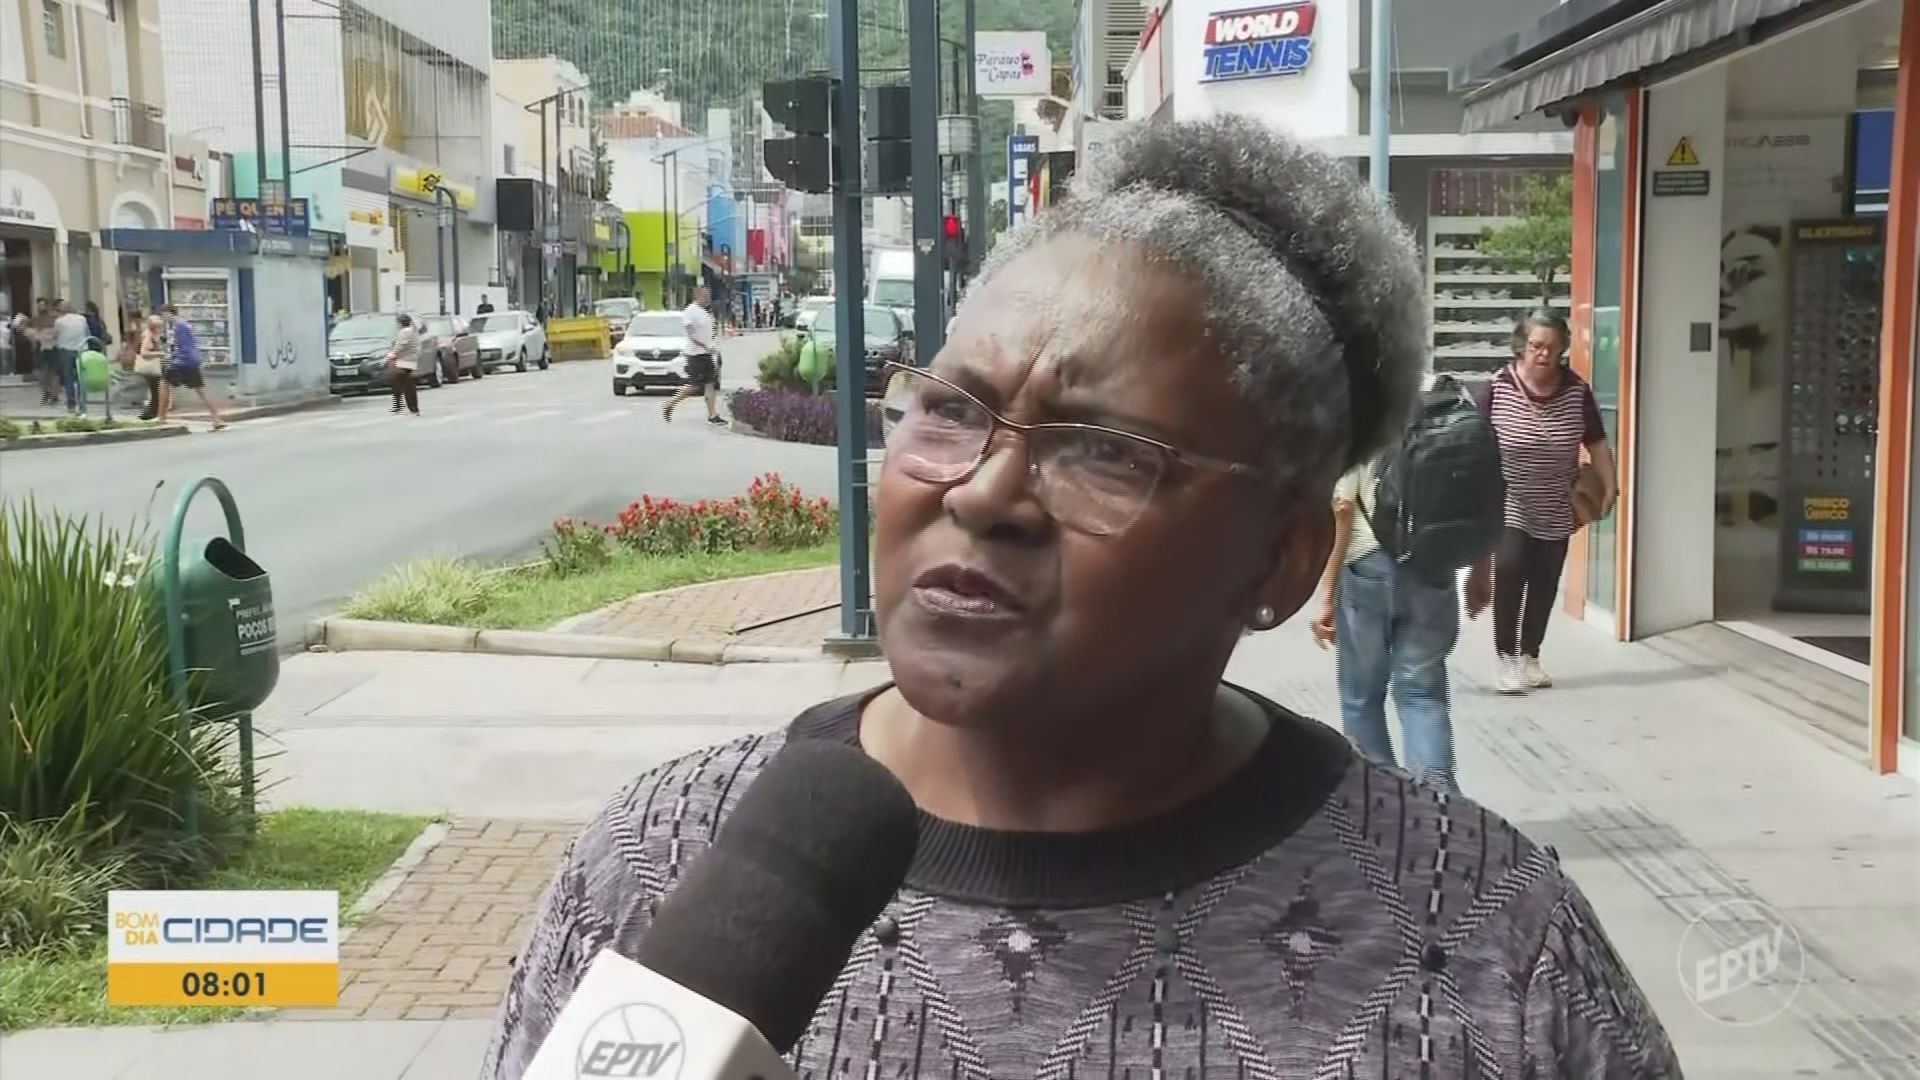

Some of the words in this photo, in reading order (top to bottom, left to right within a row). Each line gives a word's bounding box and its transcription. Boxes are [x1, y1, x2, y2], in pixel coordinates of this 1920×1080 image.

[1215, 11, 1299, 42] WORLD
[1204, 38, 1312, 76] TENNIS
[582, 1040, 680, 1076] EPTV
